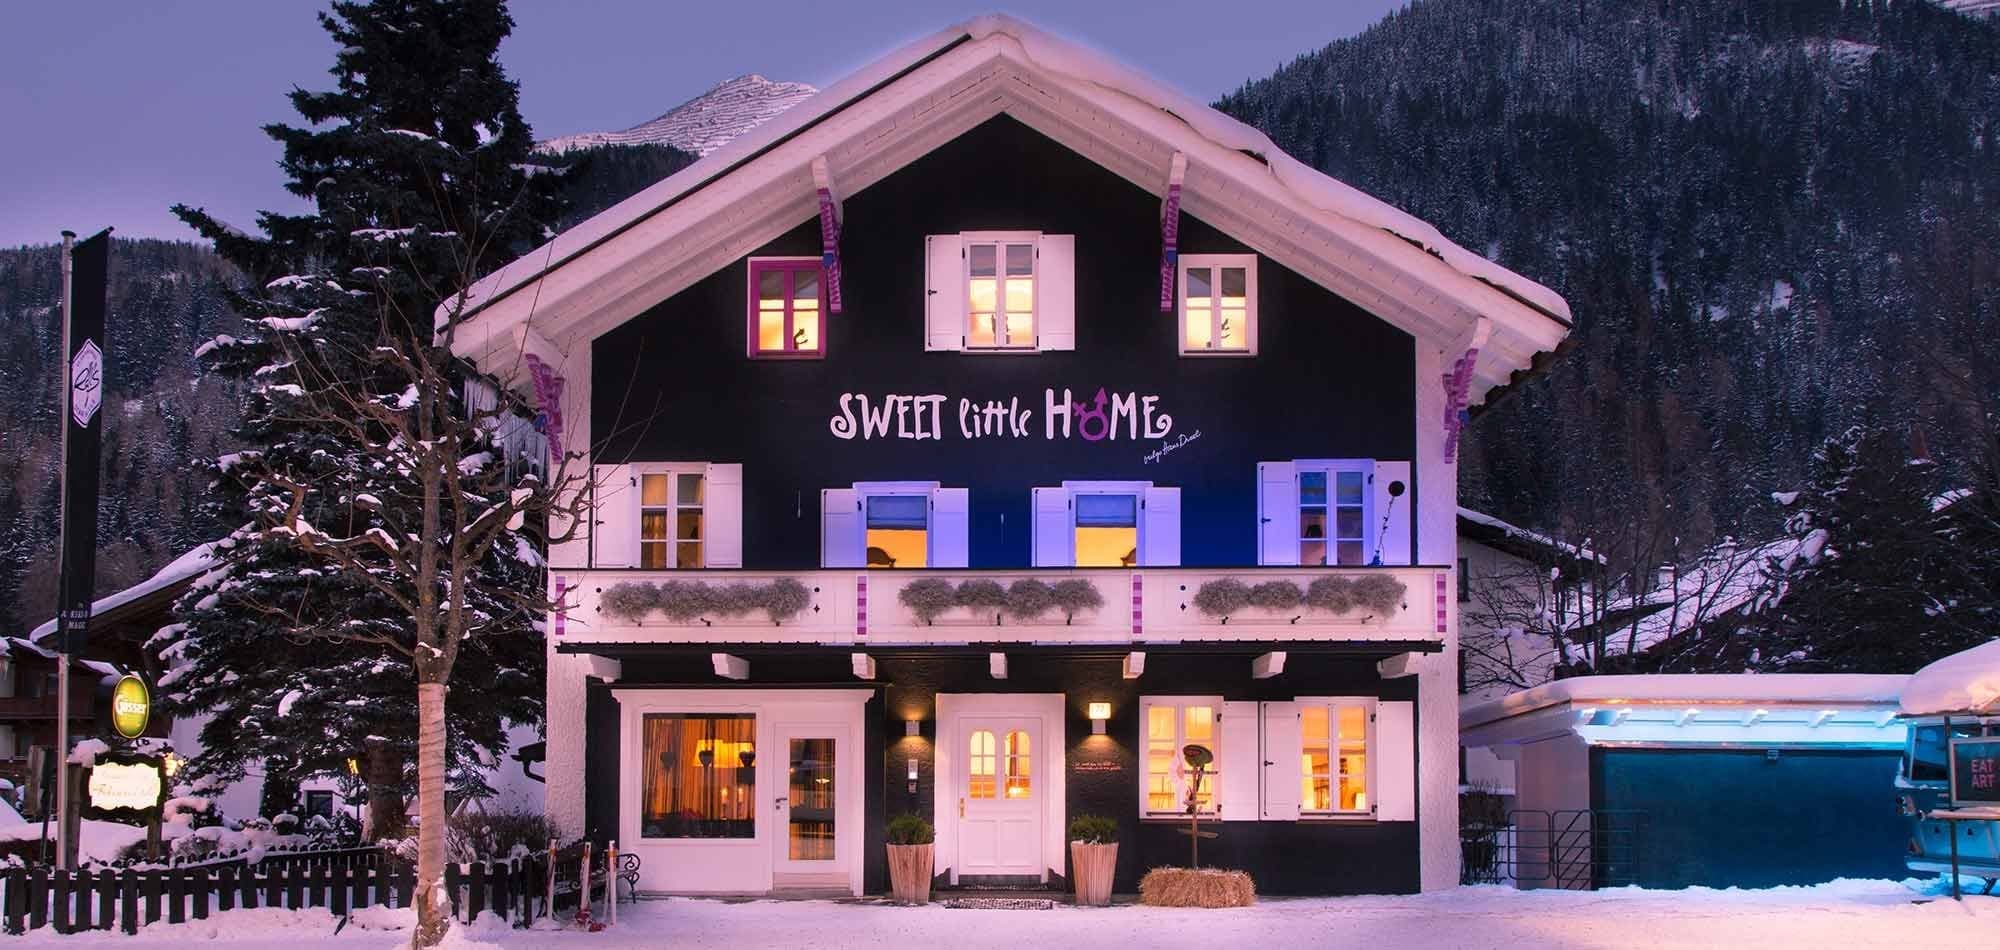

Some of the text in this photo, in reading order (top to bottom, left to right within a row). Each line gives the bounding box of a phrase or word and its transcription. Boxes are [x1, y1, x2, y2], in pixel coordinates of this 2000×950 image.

[830, 387, 1173, 441] SWEET little HOME
[1972, 759, 1994, 772] EAT
[1972, 774, 1995, 788] ART
